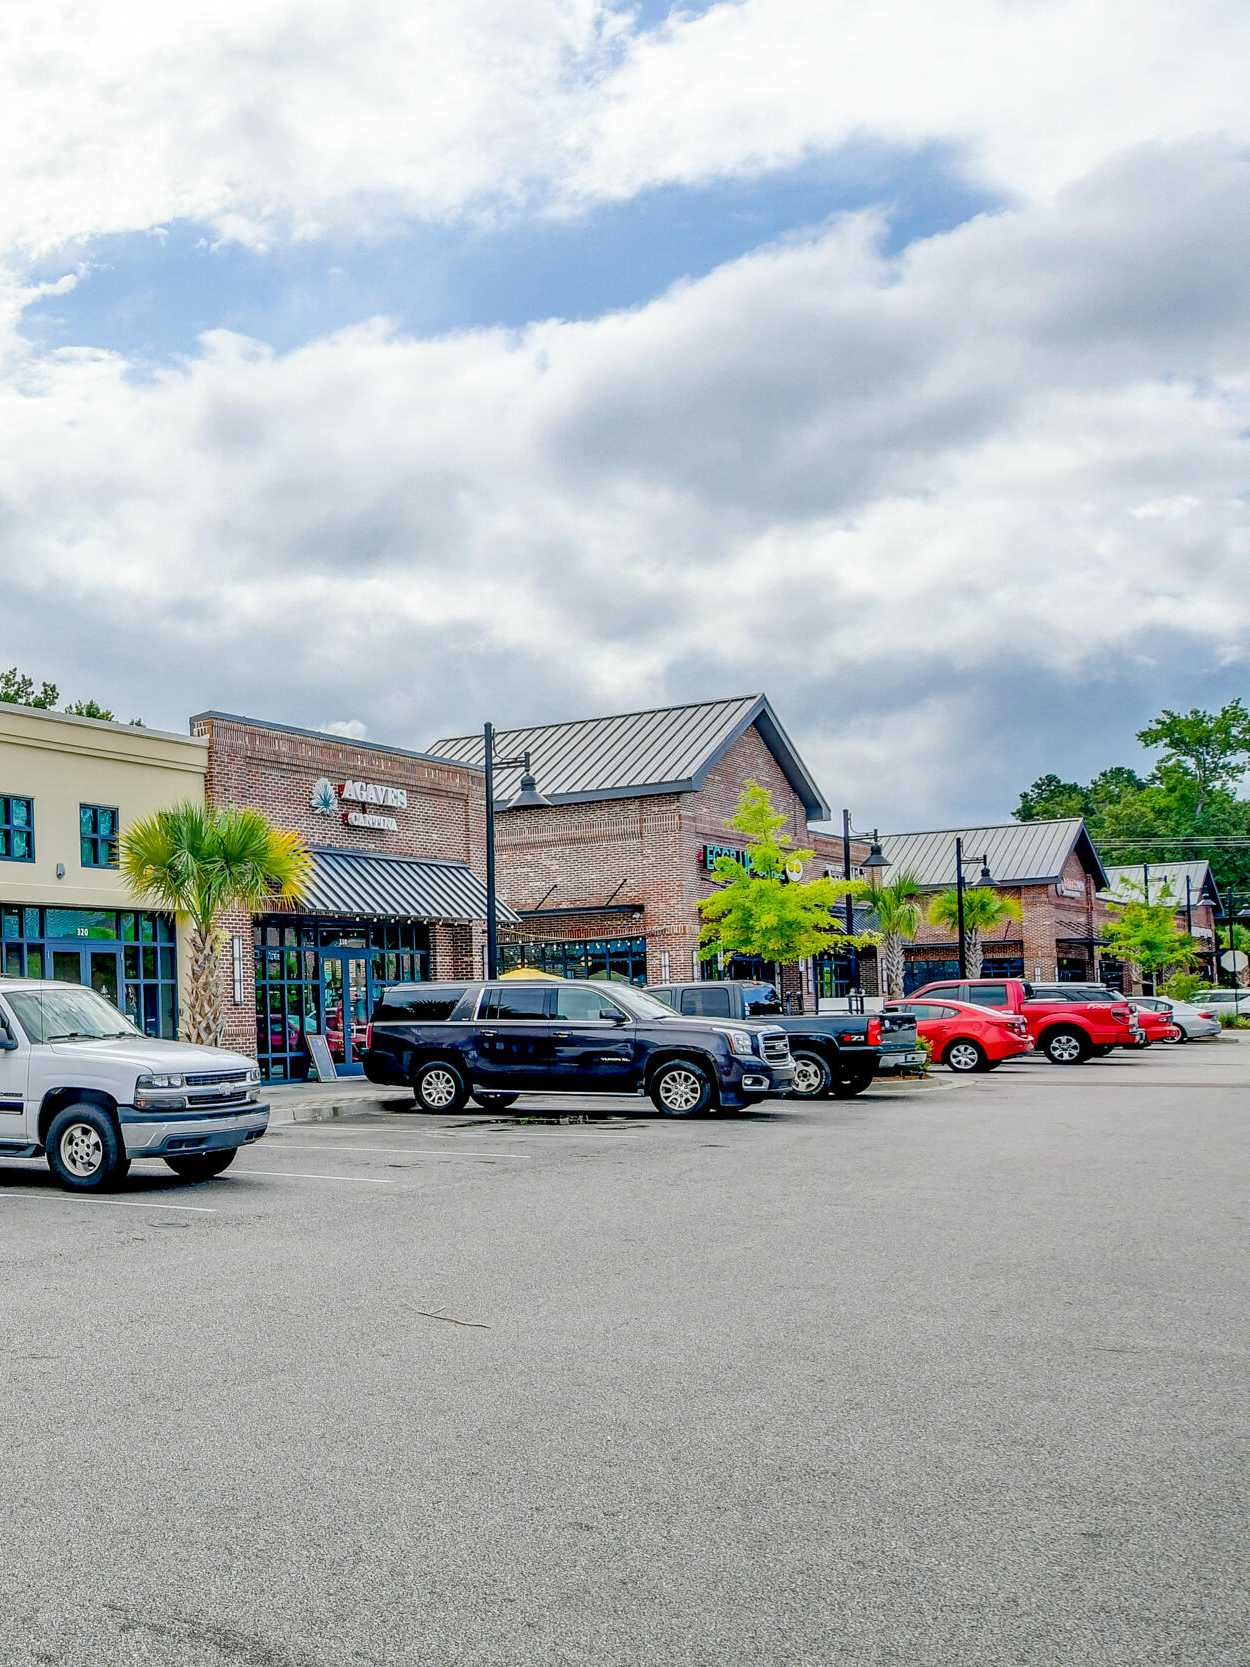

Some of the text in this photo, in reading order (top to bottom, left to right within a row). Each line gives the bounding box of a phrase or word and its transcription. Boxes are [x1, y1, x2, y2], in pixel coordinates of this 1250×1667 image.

[341, 780, 408, 808] AGAVES
[348, 813, 398, 831] CANTINA
[77, 928, 89, 936] 320
